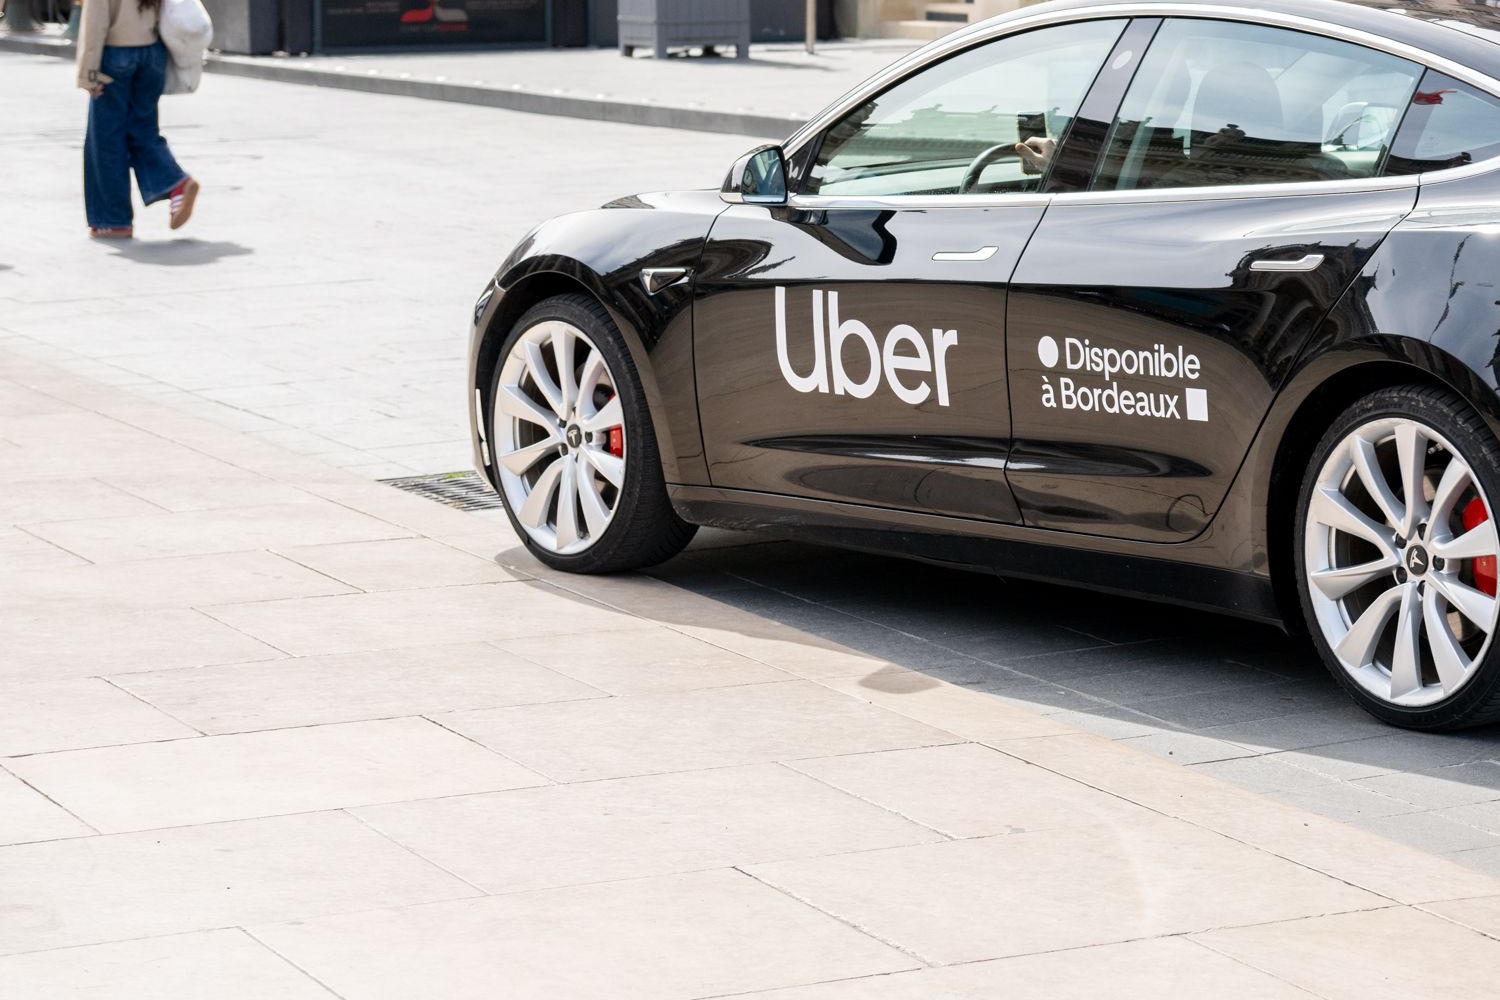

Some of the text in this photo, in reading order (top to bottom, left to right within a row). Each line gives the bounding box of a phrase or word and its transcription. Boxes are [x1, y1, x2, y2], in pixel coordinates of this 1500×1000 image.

[775, 286, 958, 407] Uber
[1065, 337, 1201, 381] Disponible
[1041, 375, 1181, 419] à Bordeaux
